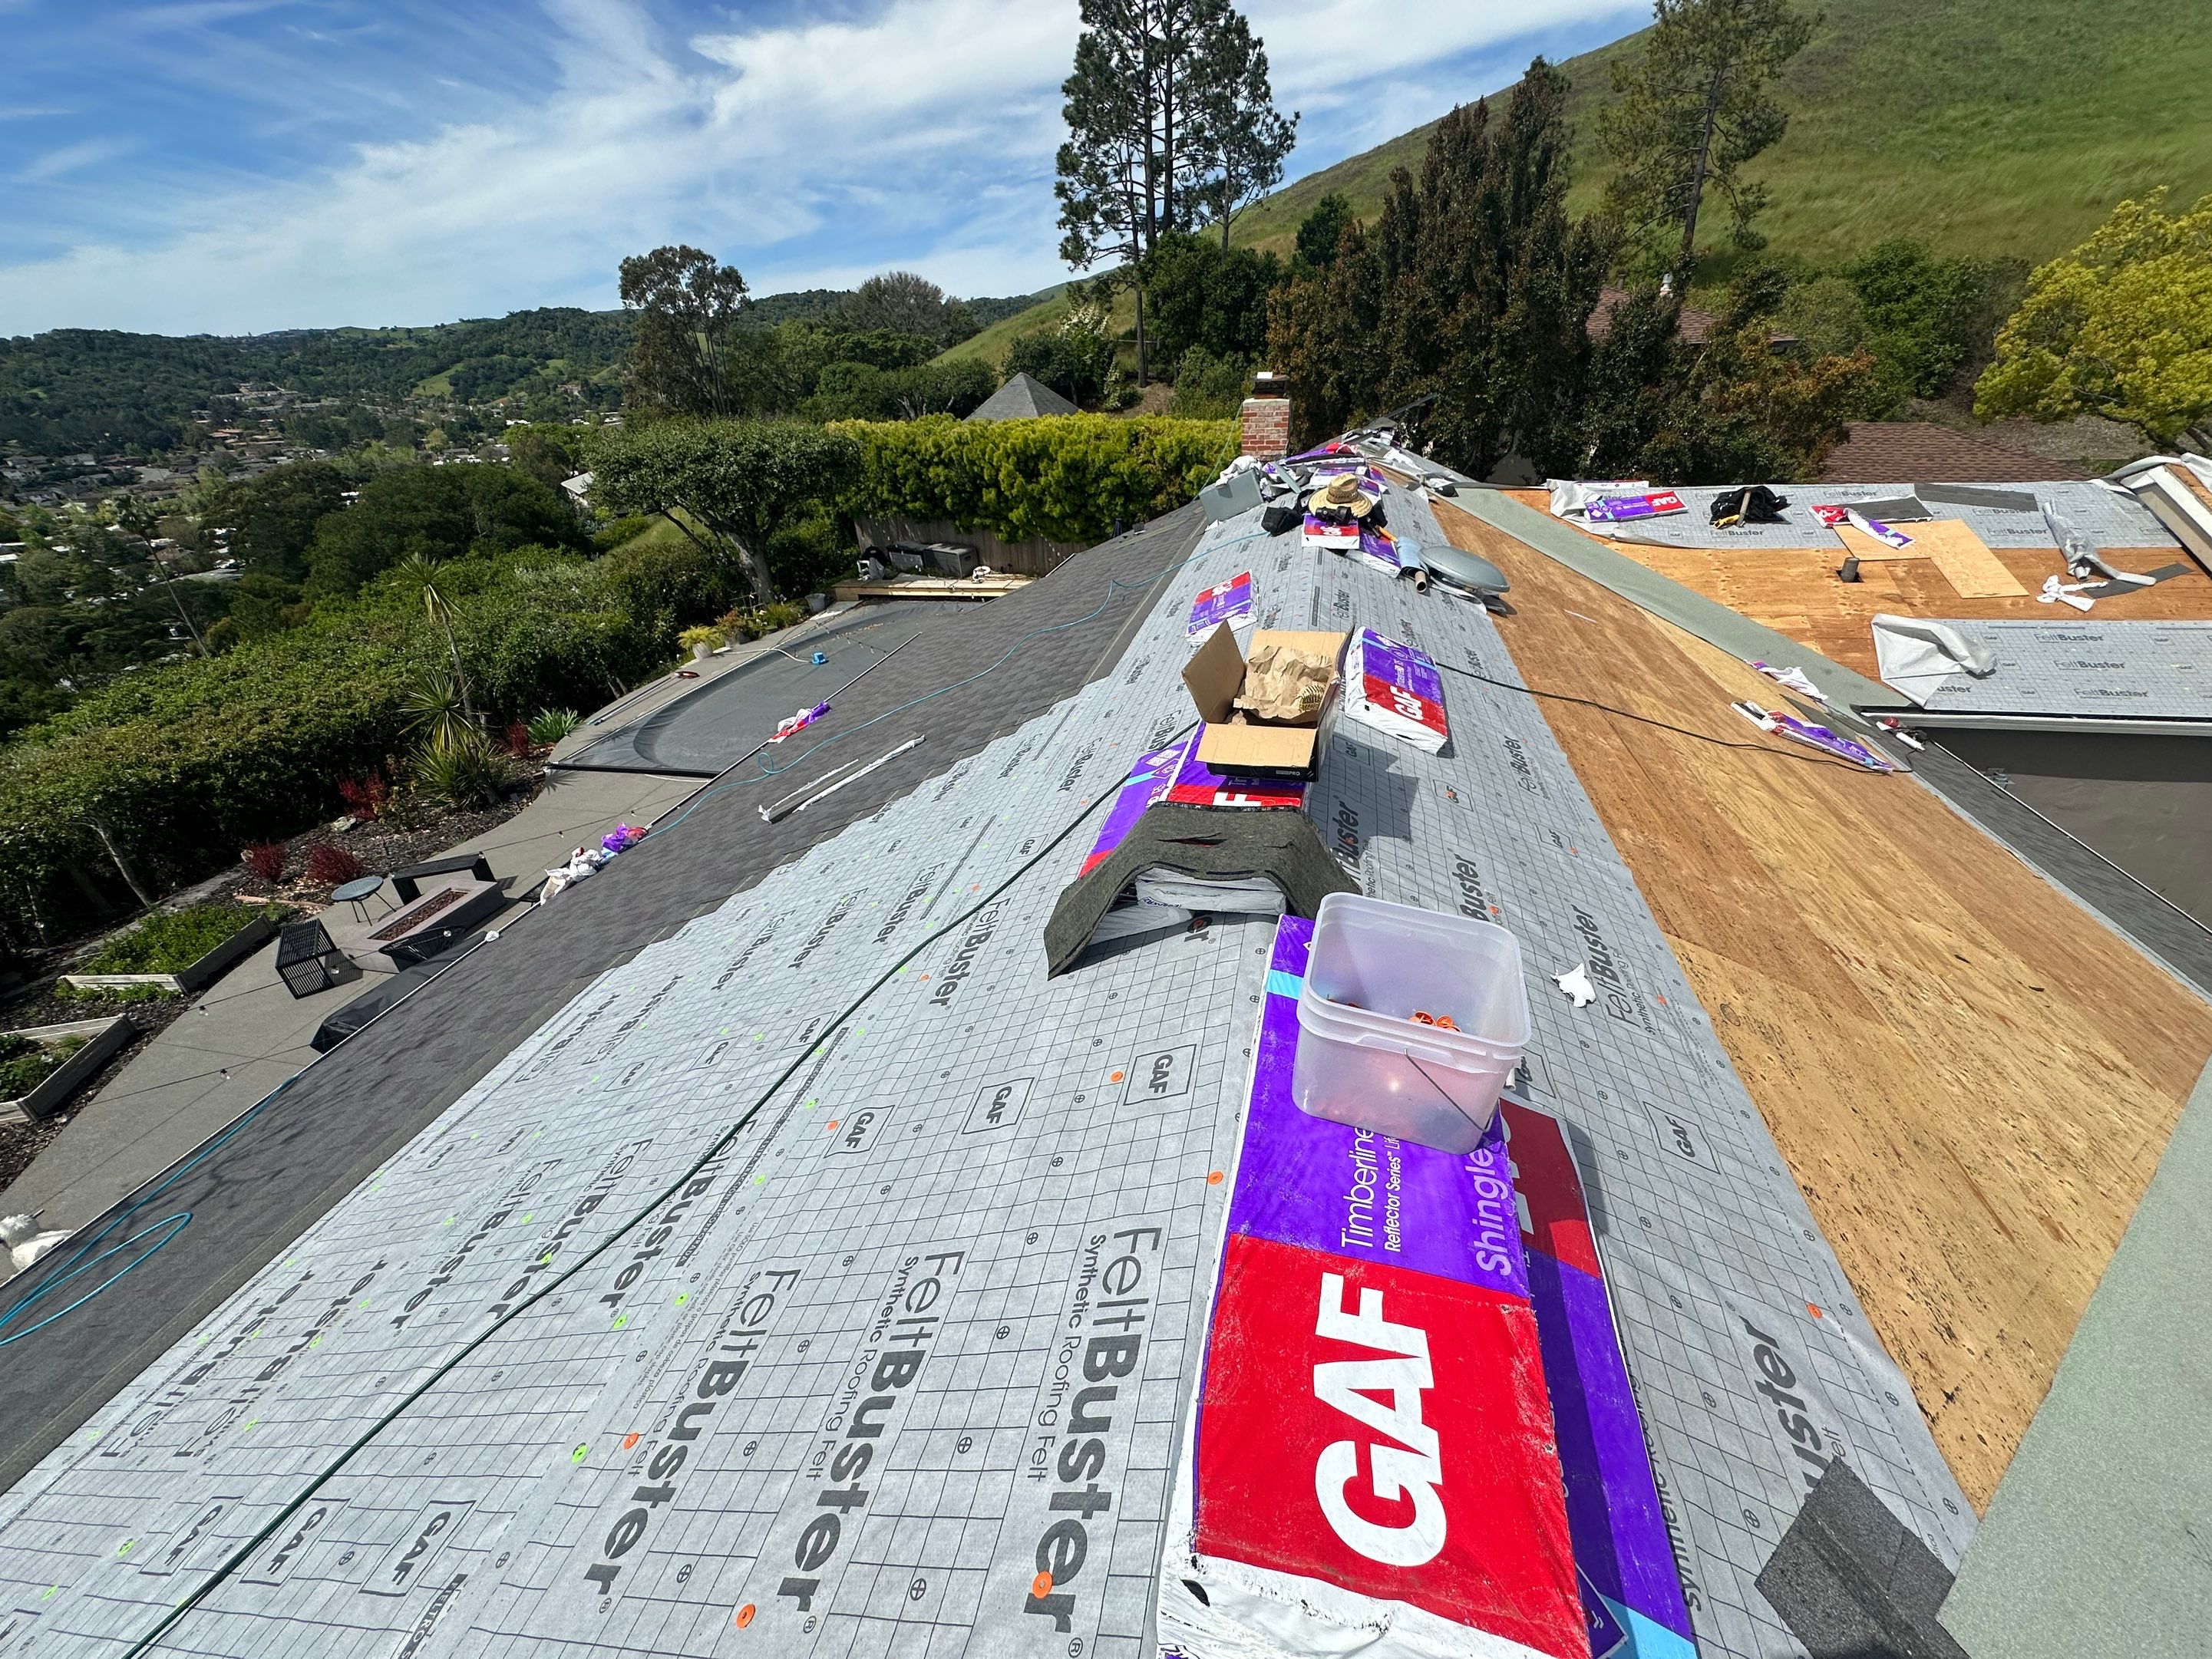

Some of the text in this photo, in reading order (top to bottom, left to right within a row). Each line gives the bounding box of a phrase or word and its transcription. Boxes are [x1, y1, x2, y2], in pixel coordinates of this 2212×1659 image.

[2034, 633, 2105, 642] FeltBuster
[2054, 660, 2125, 670] FeltBuster
[1390, 686, 1424, 721] GAF
[1937, 685, 1971, 694] uster
[2074, 688, 2149, 699] FeltBuster
[1148, 710, 1182, 750] FeltBus
[1057, 737, 1103, 792] FeltBuster
[1503, 734, 1541, 797] FeltBuster
[1019, 839, 1035, 856] GAF
[872, 862, 946, 944] FeltBuster
[1451, 853, 1491, 922] Buster
[711, 909, 797, 991] FeltBuster
[787, 887, 870, 968] FeltBuster
[1571, 904, 1640, 1028] FeltBuster
[514, 994, 621, 1083] FeltBuster
[798, 1017, 820, 1043] GAF
[1630, 992, 1656, 1035] Synthetic
[705, 1041, 729, 1065] GAF
[1148, 1054, 1174, 1094] GAF
[845, 1111, 874, 1149] GAF
[985, 1085, 1012, 1126] GAF
[1665, 1114, 1695, 1158] GAF
[1341, 1126, 1379, 1248] Timberline
[487, 1138, 654, 1321] FeltBuster
[1383, 1192, 1401, 1253] Reflector
[100, 1270, 315, 1457] FeltBuster
[652, 1349, 675, 1378] cabeza
[654, 1345, 667, 1360] cap
[671, 1338, 682, 1349] de
[804, 1255, 920, 1483] Synthetic Roofing Felt
[1027, 1232, 1107, 1483] Synthetic Roofing Felt
[626, 1271, 761, 1478] Synthetic Roofing Felt
[1314, 1272, 1448, 1568] GAF
[1738, 1314, 1831, 1498] uster
[1821, 1426, 1847, 1457] elt
[165, 1504, 224, 1567] GAF
[267, 1506, 328, 1575] GAF
[390, 1509, 453, 1586] GAF
[412, 1581, 461, 1642] FIELTRO
